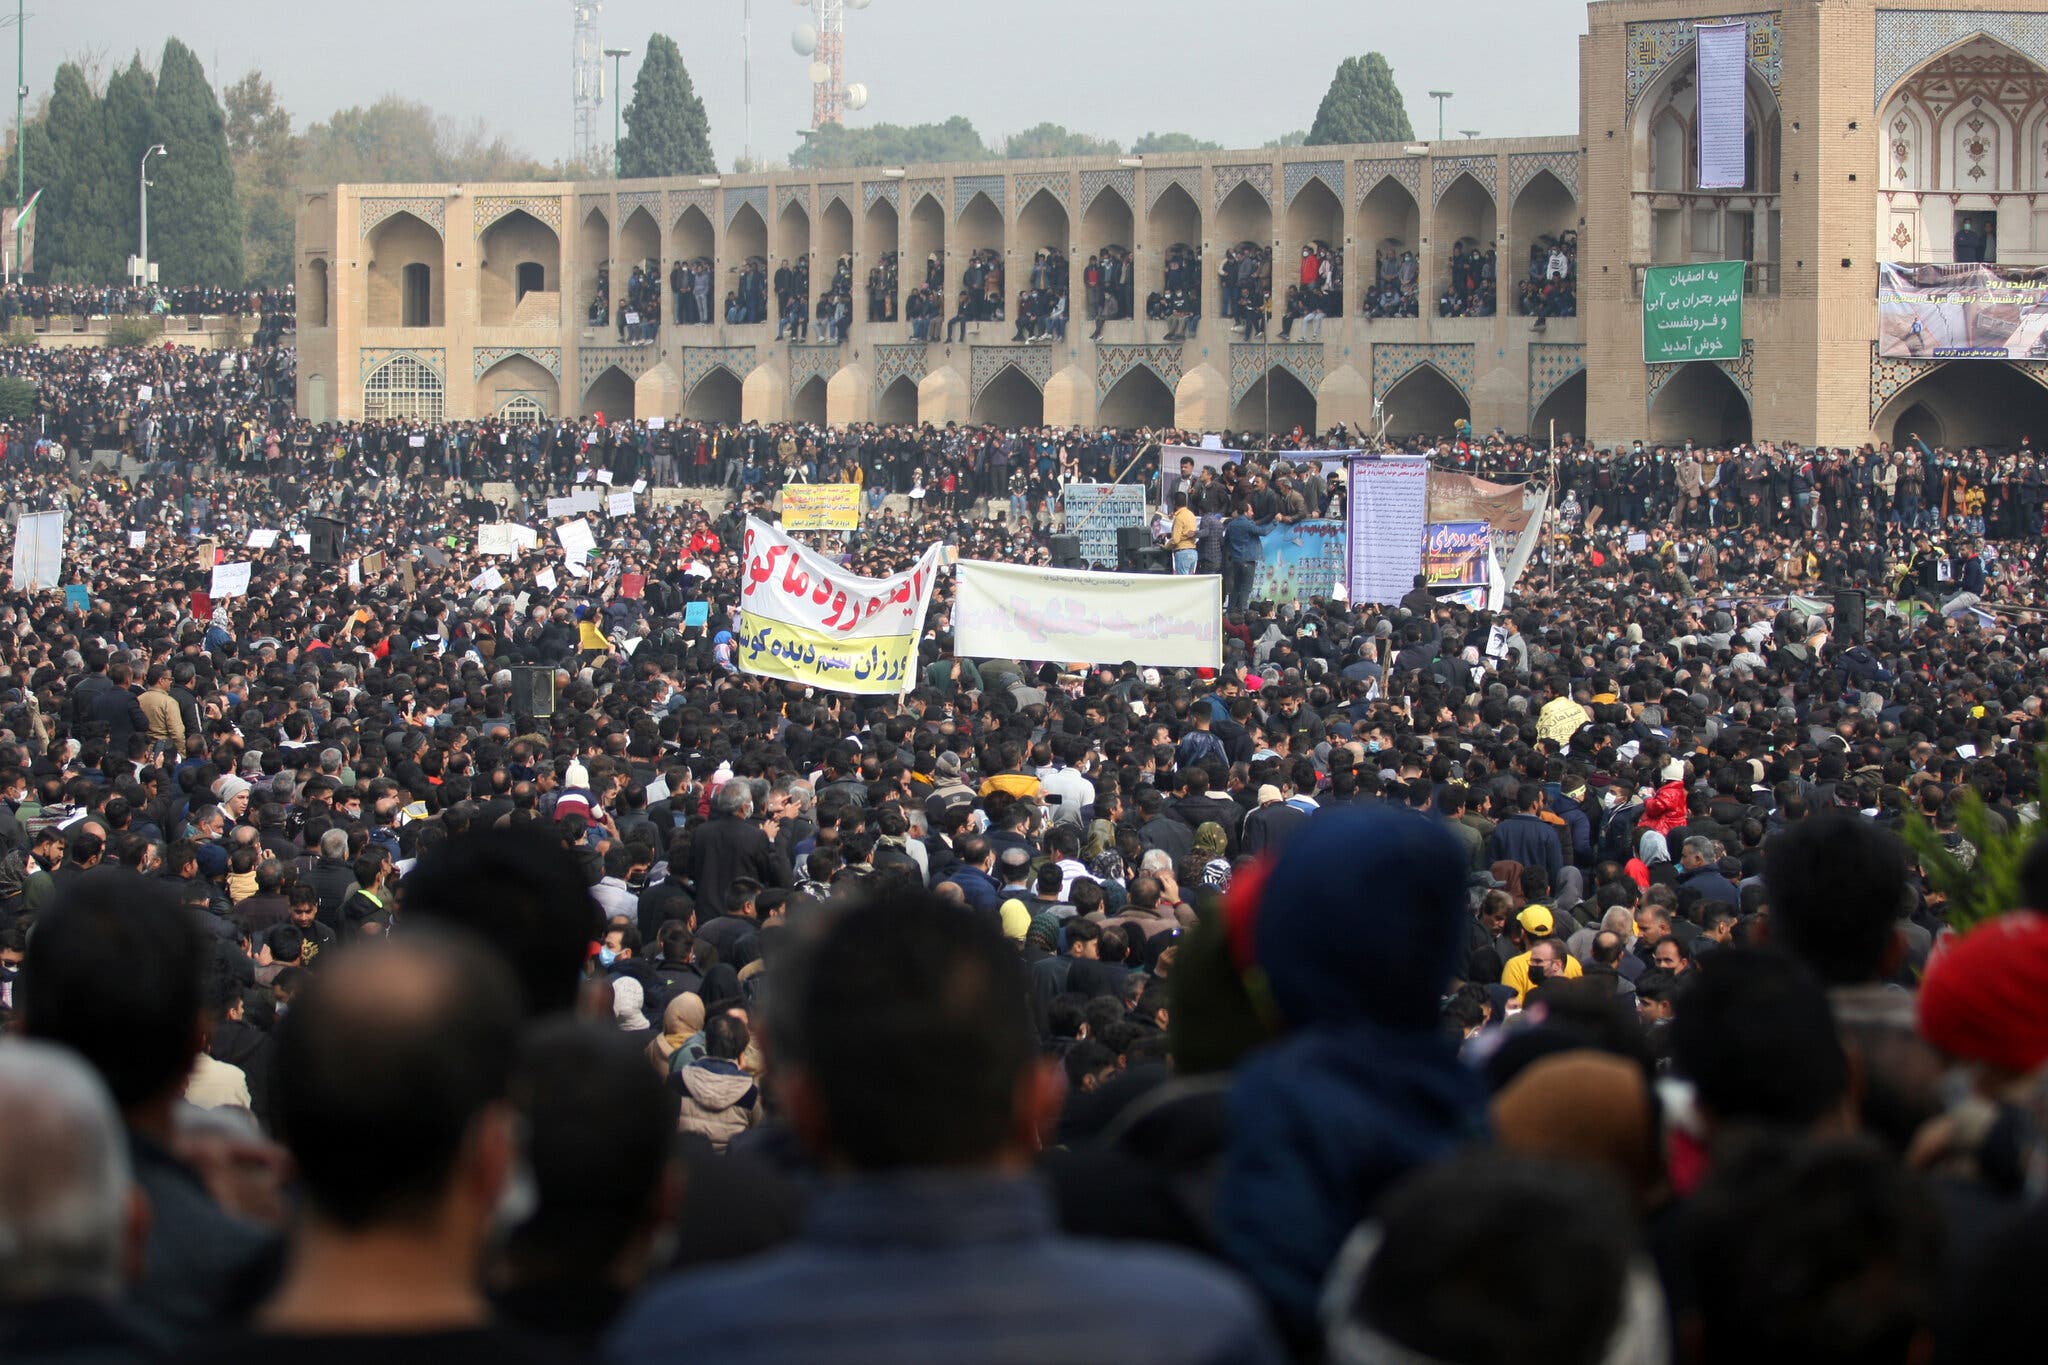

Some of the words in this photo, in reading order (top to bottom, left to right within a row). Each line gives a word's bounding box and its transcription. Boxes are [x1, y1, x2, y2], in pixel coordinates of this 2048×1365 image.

[1669, 269, 1704, 286] اصفهان
[1707, 270, 1719, 284] به
[1985, 280, 2003, 290] رود
[2006, 279, 2035, 290] زاینده
[1646, 292, 1666, 311] آبی
[1666, 295, 1680, 310] بی
[1682, 292, 1713, 308] بحران
[1714, 289, 1738, 307] شهر
[1979, 295, 2034, 304] فرونشست
[1657, 313, 1718, 331] فرونشست
[1720, 316, 1727, 330] و
[1661, 335, 1693, 355] آمدید
[1694, 337, 1723, 355] خوش
[783, 553, 809, 597] ما
[812, 577, 860, 631] رود
[771, 639, 815, 669] دیده
